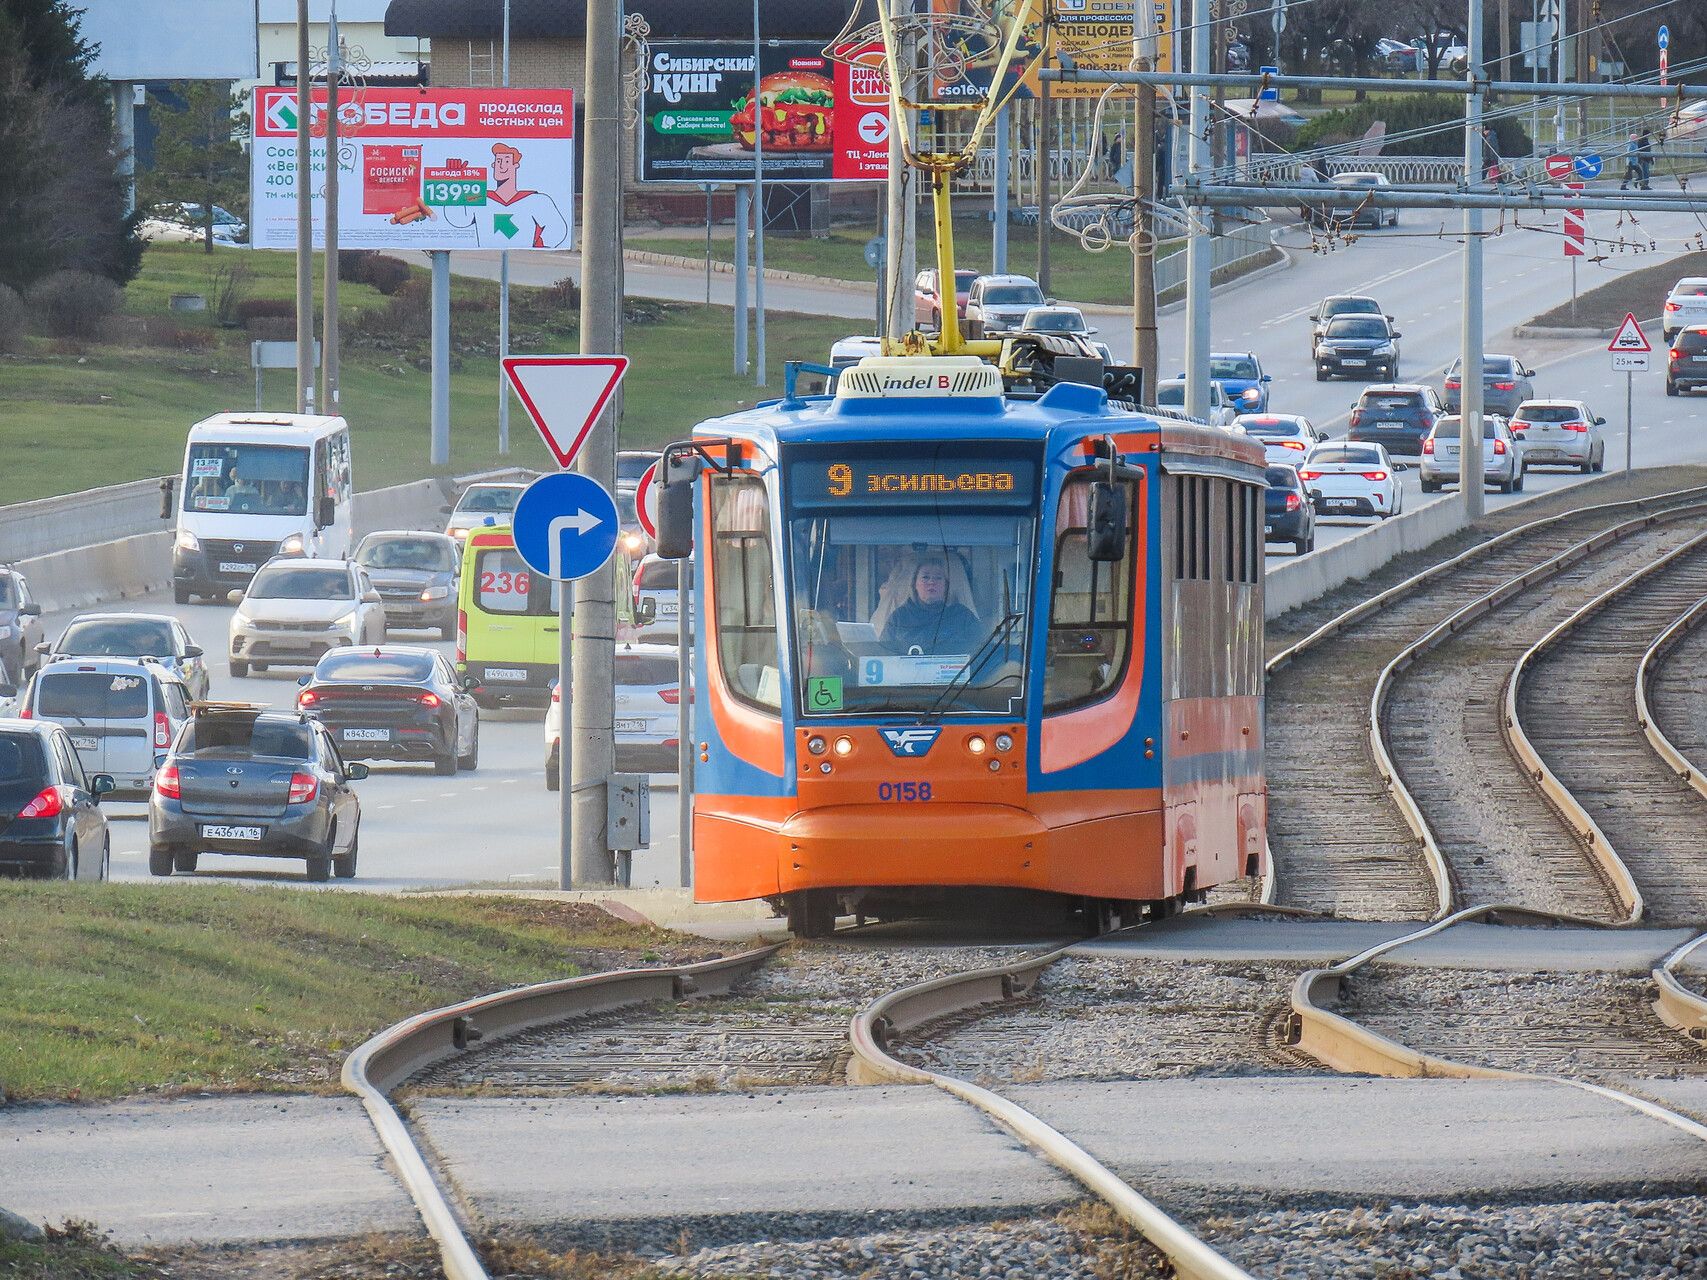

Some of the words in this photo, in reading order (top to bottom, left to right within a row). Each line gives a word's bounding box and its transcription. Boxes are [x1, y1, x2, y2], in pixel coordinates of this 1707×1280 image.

[937, 84, 990, 95] cso16.ru
[479, 103, 564, 115] продсклад
[479, 117, 535, 126] честных
[538, 117, 564, 127] цен
[846, 150, 860, 159] ТЦ
[370, 167, 415, 177] СОСИСКИ
[430, 169, 462, 177] выгода
[463, 169, 481, 177] 18%
[266, 175, 294, 186] 400
[883, 375, 933, 389] indel
[938, 375, 950, 389] B
[828, 464, 853, 496] 9
[480, 571, 531, 595] 236
[865, 659, 884, 685] 9
[878, 782, 932, 801] 0158
[207, 826, 245, 838] Е436УА
[248, 827, 259, 837] 16
